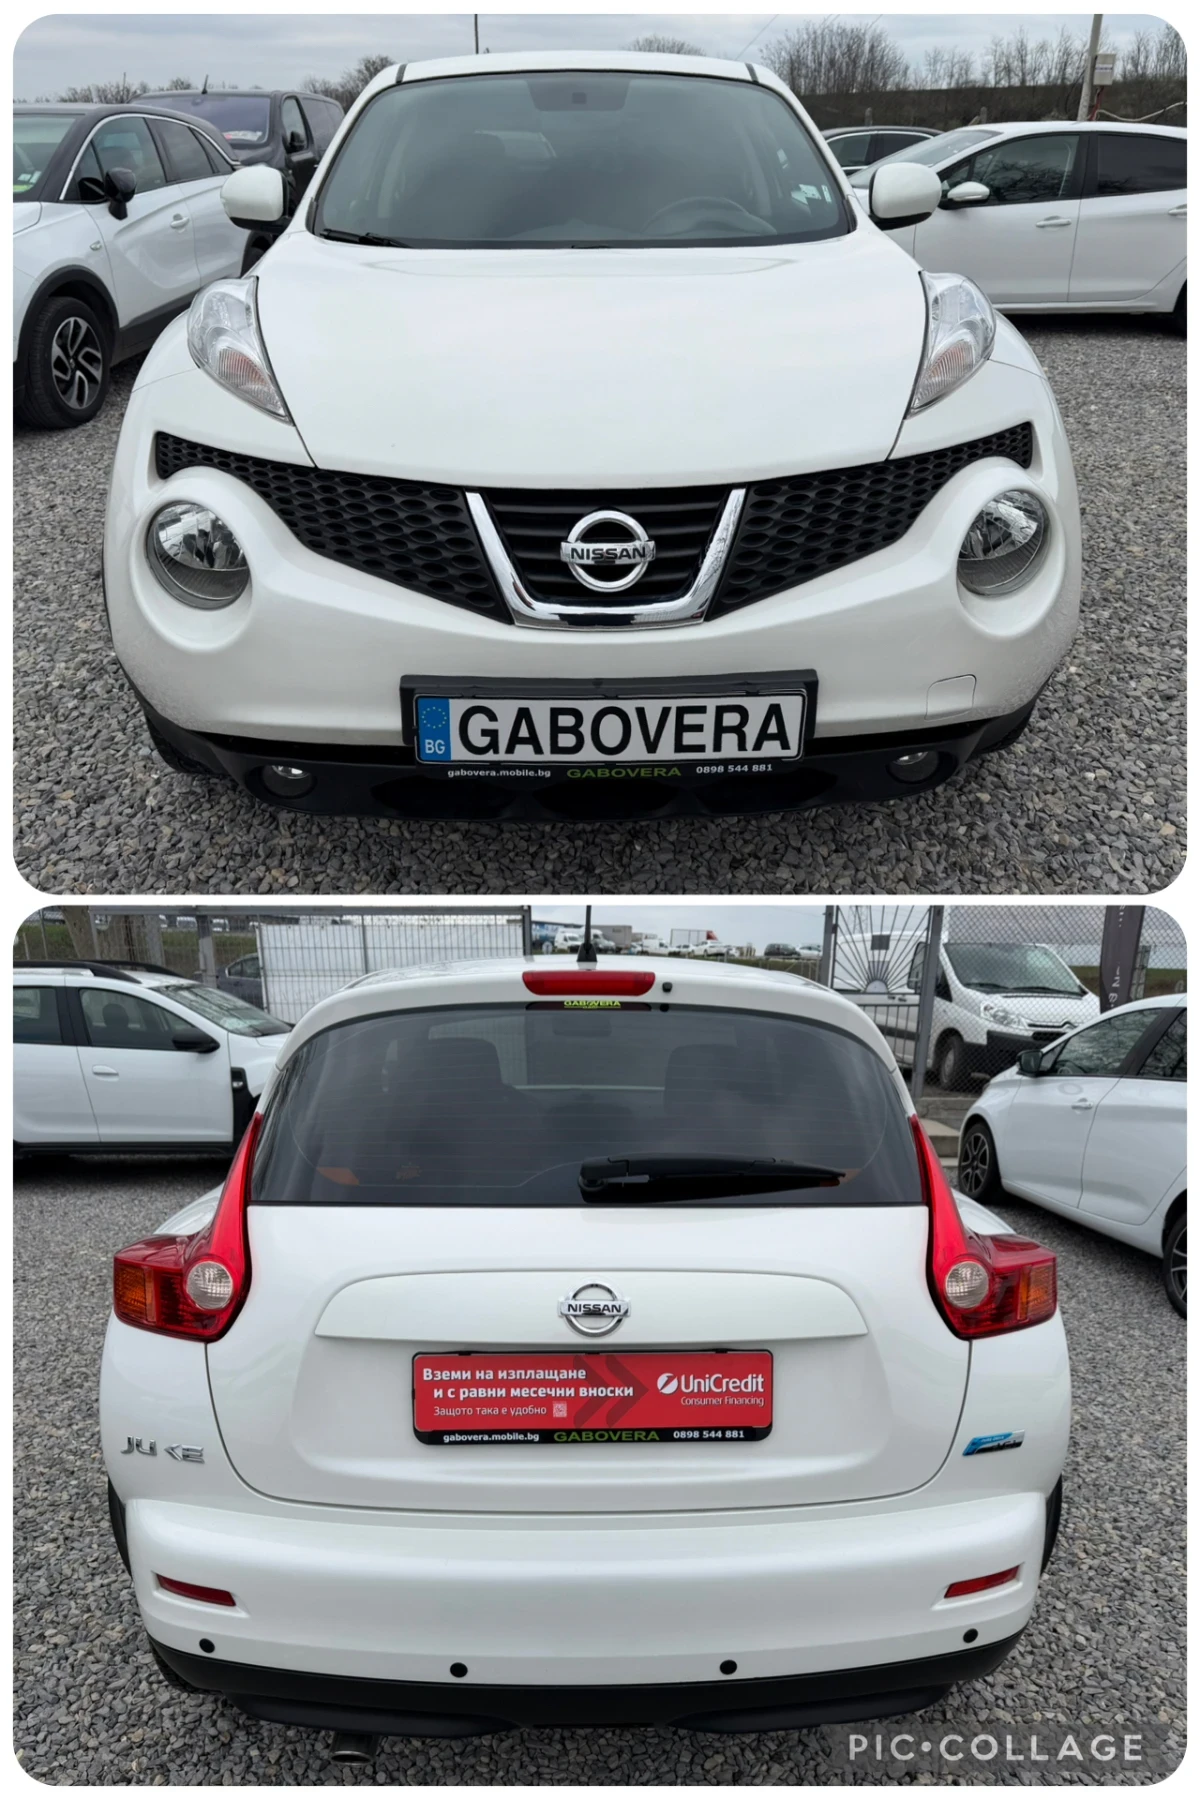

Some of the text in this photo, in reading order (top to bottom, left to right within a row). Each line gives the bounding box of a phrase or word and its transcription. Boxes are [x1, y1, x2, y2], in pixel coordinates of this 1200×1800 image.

[571, 547, 646, 561] NISSAN
[458, 703, 791, 756] GABOVERA
[424, 739, 446, 755] BG
[447, 768, 551, 778] gabovera.mobile.bg
[567, 767, 682, 779] GABOVERA
[696, 763, 773, 774] 0898 544 881
[567, 1303, 622, 1313] NISSAN
[423, 1368, 586, 1382] Вземи на изплащане
[681, 1373, 765, 1393] UniCredit
[433, 1386, 634, 1401] и с равни месечни вноски
[681, 1396, 765, 1406] Consumer Financing
[433, 1405, 547, 1417] Защото така е удобно
[443, 1432, 540, 1443] gabovera.mobile.bg
[553, 1431, 660, 1442] GABOVERA
[673, 1430, 745, 1439] 0898 544 881
[120, 1435, 205, 1464] JUKE
